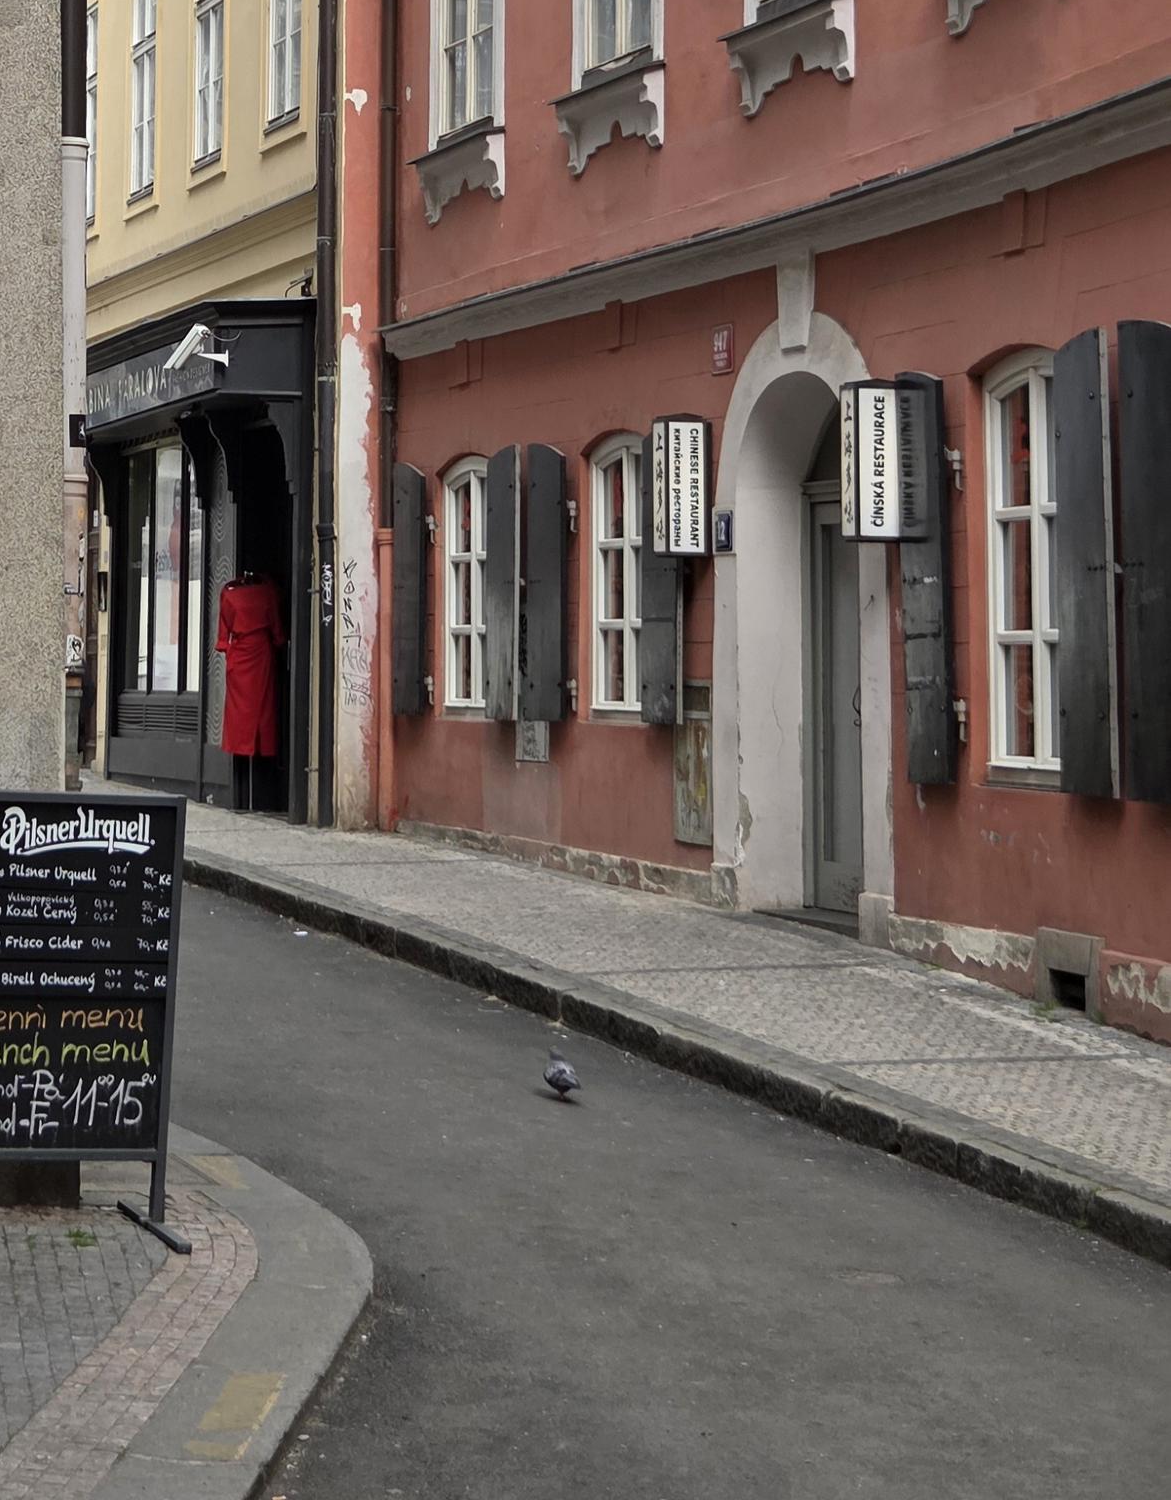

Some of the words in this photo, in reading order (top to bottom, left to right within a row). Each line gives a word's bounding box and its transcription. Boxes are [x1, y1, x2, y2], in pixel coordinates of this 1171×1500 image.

[873, 395, 885, 477] RESTAURACE
[690, 428, 699, 474] CHINESE
[690, 478, 699, 548] RESTAURANT
[870, 481, 885, 528] ČÍNSKÁ
[9, 863, 50, 878] Pilsner
[54, 866, 97, 886] Urquell
[6, 904, 38, 917] Kozel
[43, 901, 77, 924] Černý
[5, 936, 43, 948] Frisco
[49, 934, 83, 949] Cider
[1, 972, 35, 985] Birell
[60, 1007, 144, 1032] menu
[61, 1038, 150, 1067] menu
